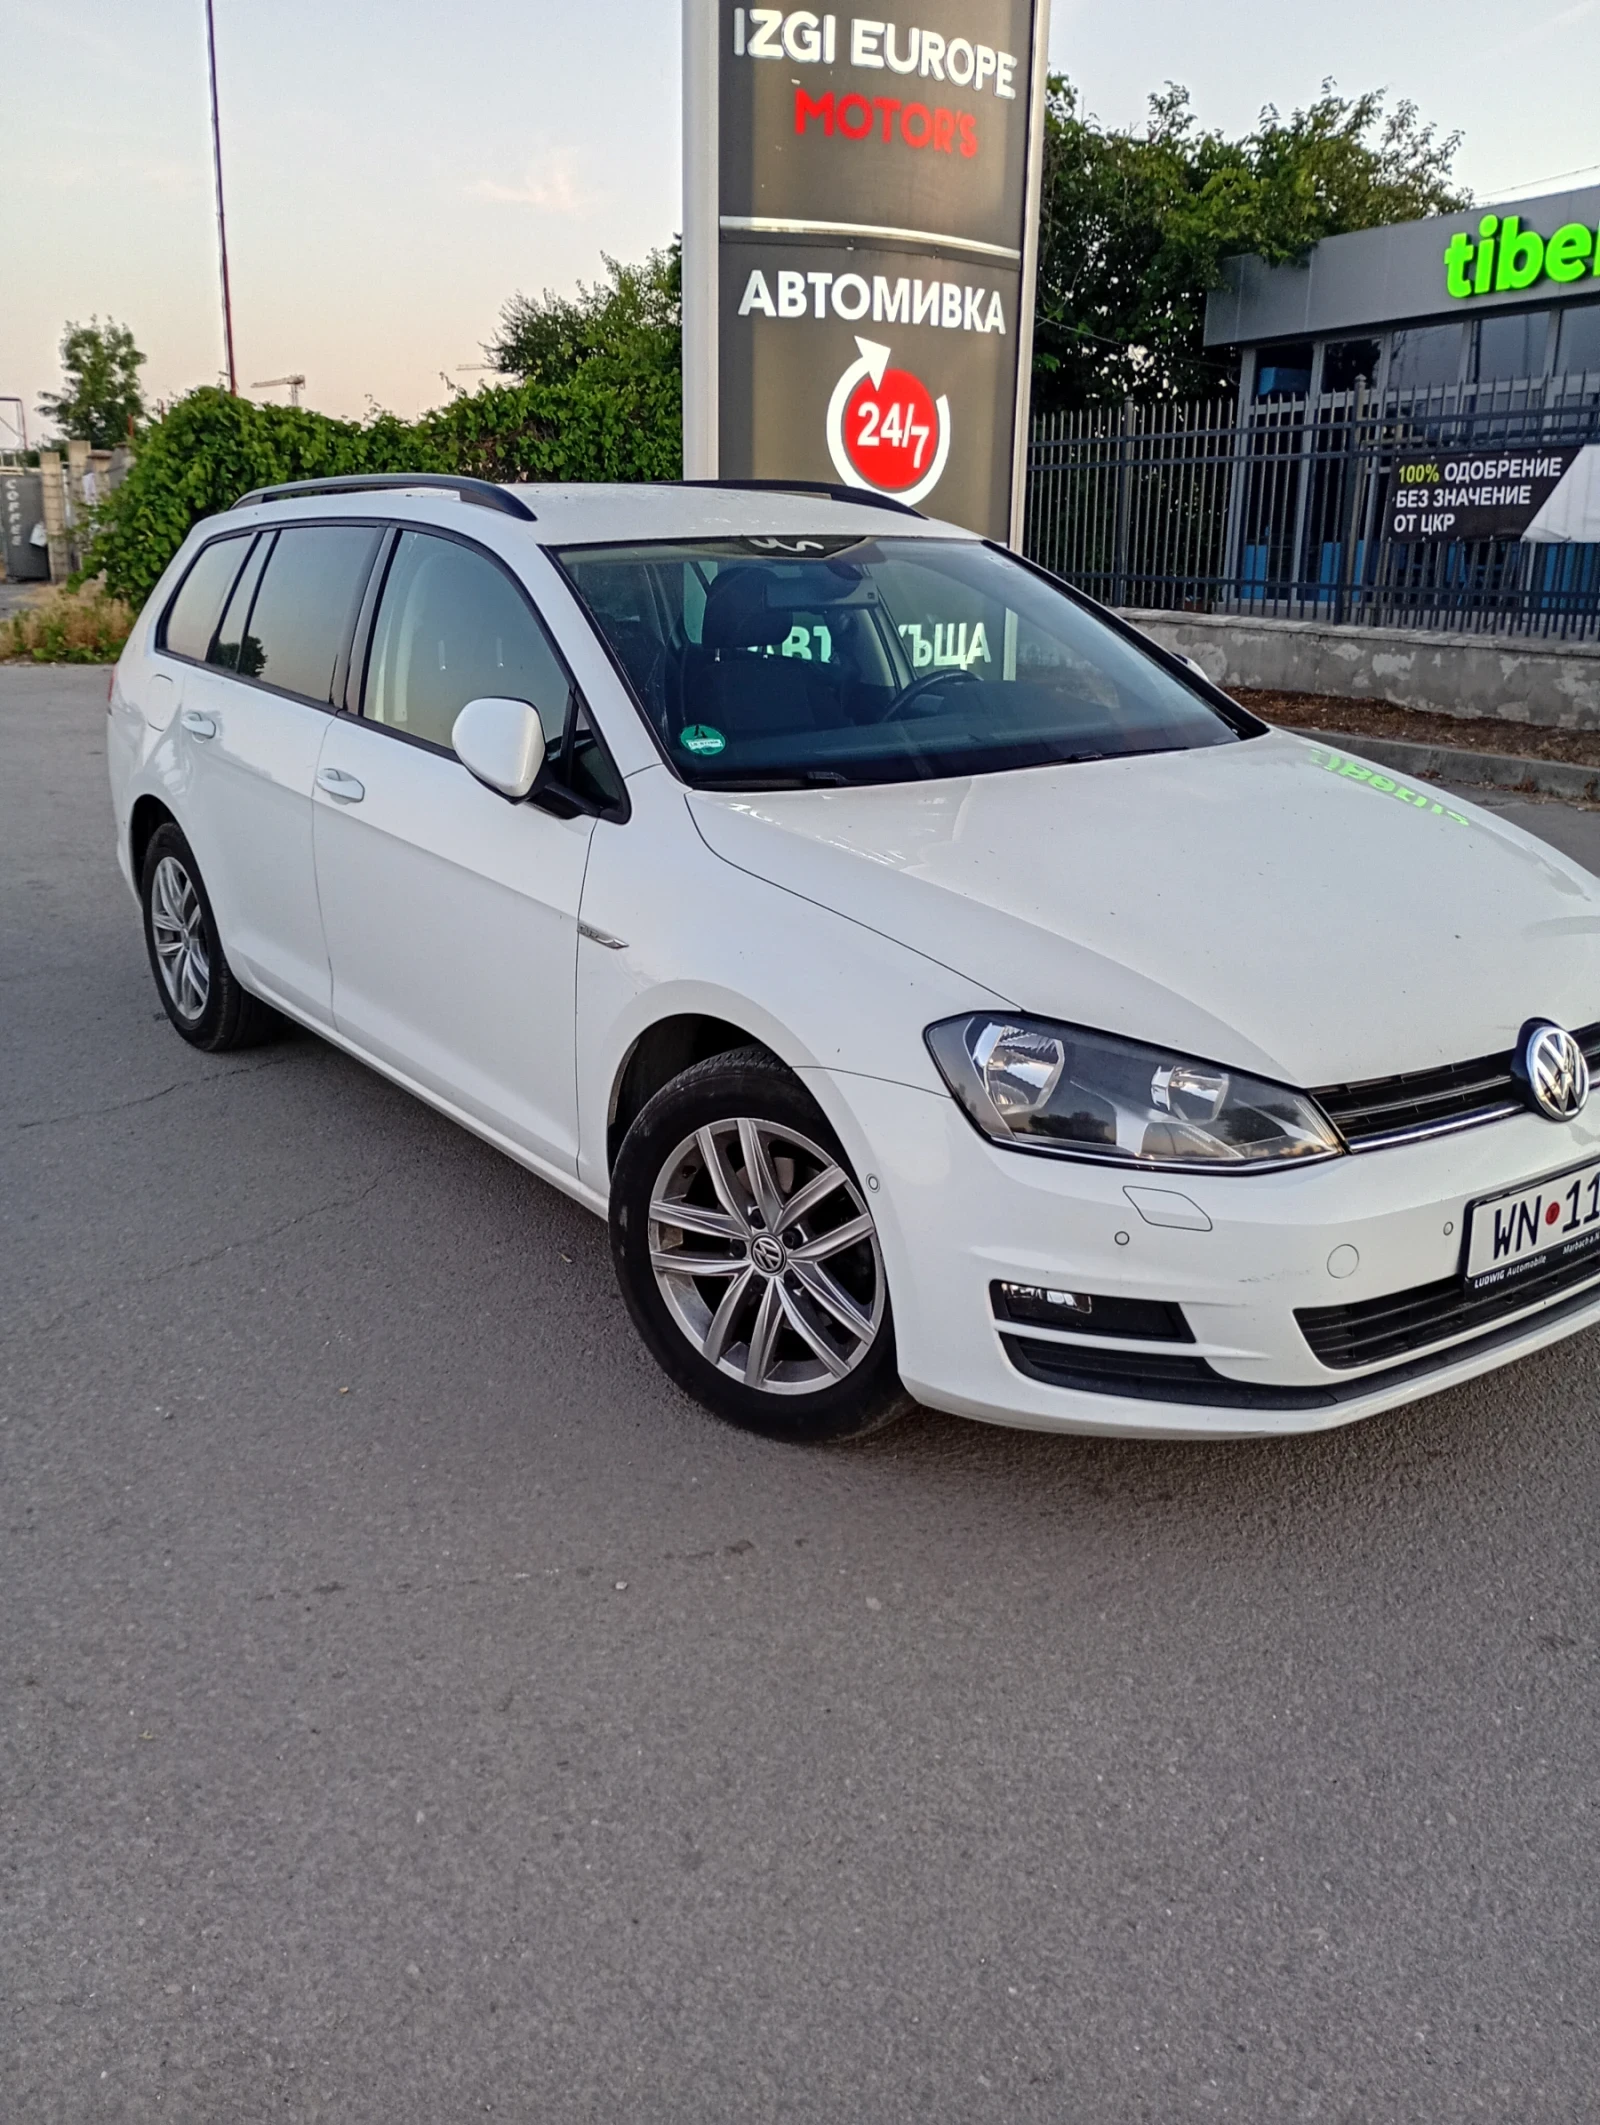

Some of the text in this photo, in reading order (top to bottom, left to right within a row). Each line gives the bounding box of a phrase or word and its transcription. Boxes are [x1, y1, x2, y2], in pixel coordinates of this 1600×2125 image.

[733, 7, 1018, 100] IZGI EUROPE
[794, 87, 978, 159] MOTOR'S
[737, 269, 1007, 335] АВТОМИВКА
[856, 402, 930, 468] 24/7
[1395, 486, 1532, 508] БЕЗ ЗНАЧЕНИЕ
[1398, 457, 1562, 484] 100% ОДОБРЕНИЕ
[1393, 514, 1455, 535] ОТ ЦКР
[1494, 1195, 1541, 1260] WN
[1474, 1269, 1506, 1289] LUDWIG
[1507, 1255, 1547, 1278] Automobile
